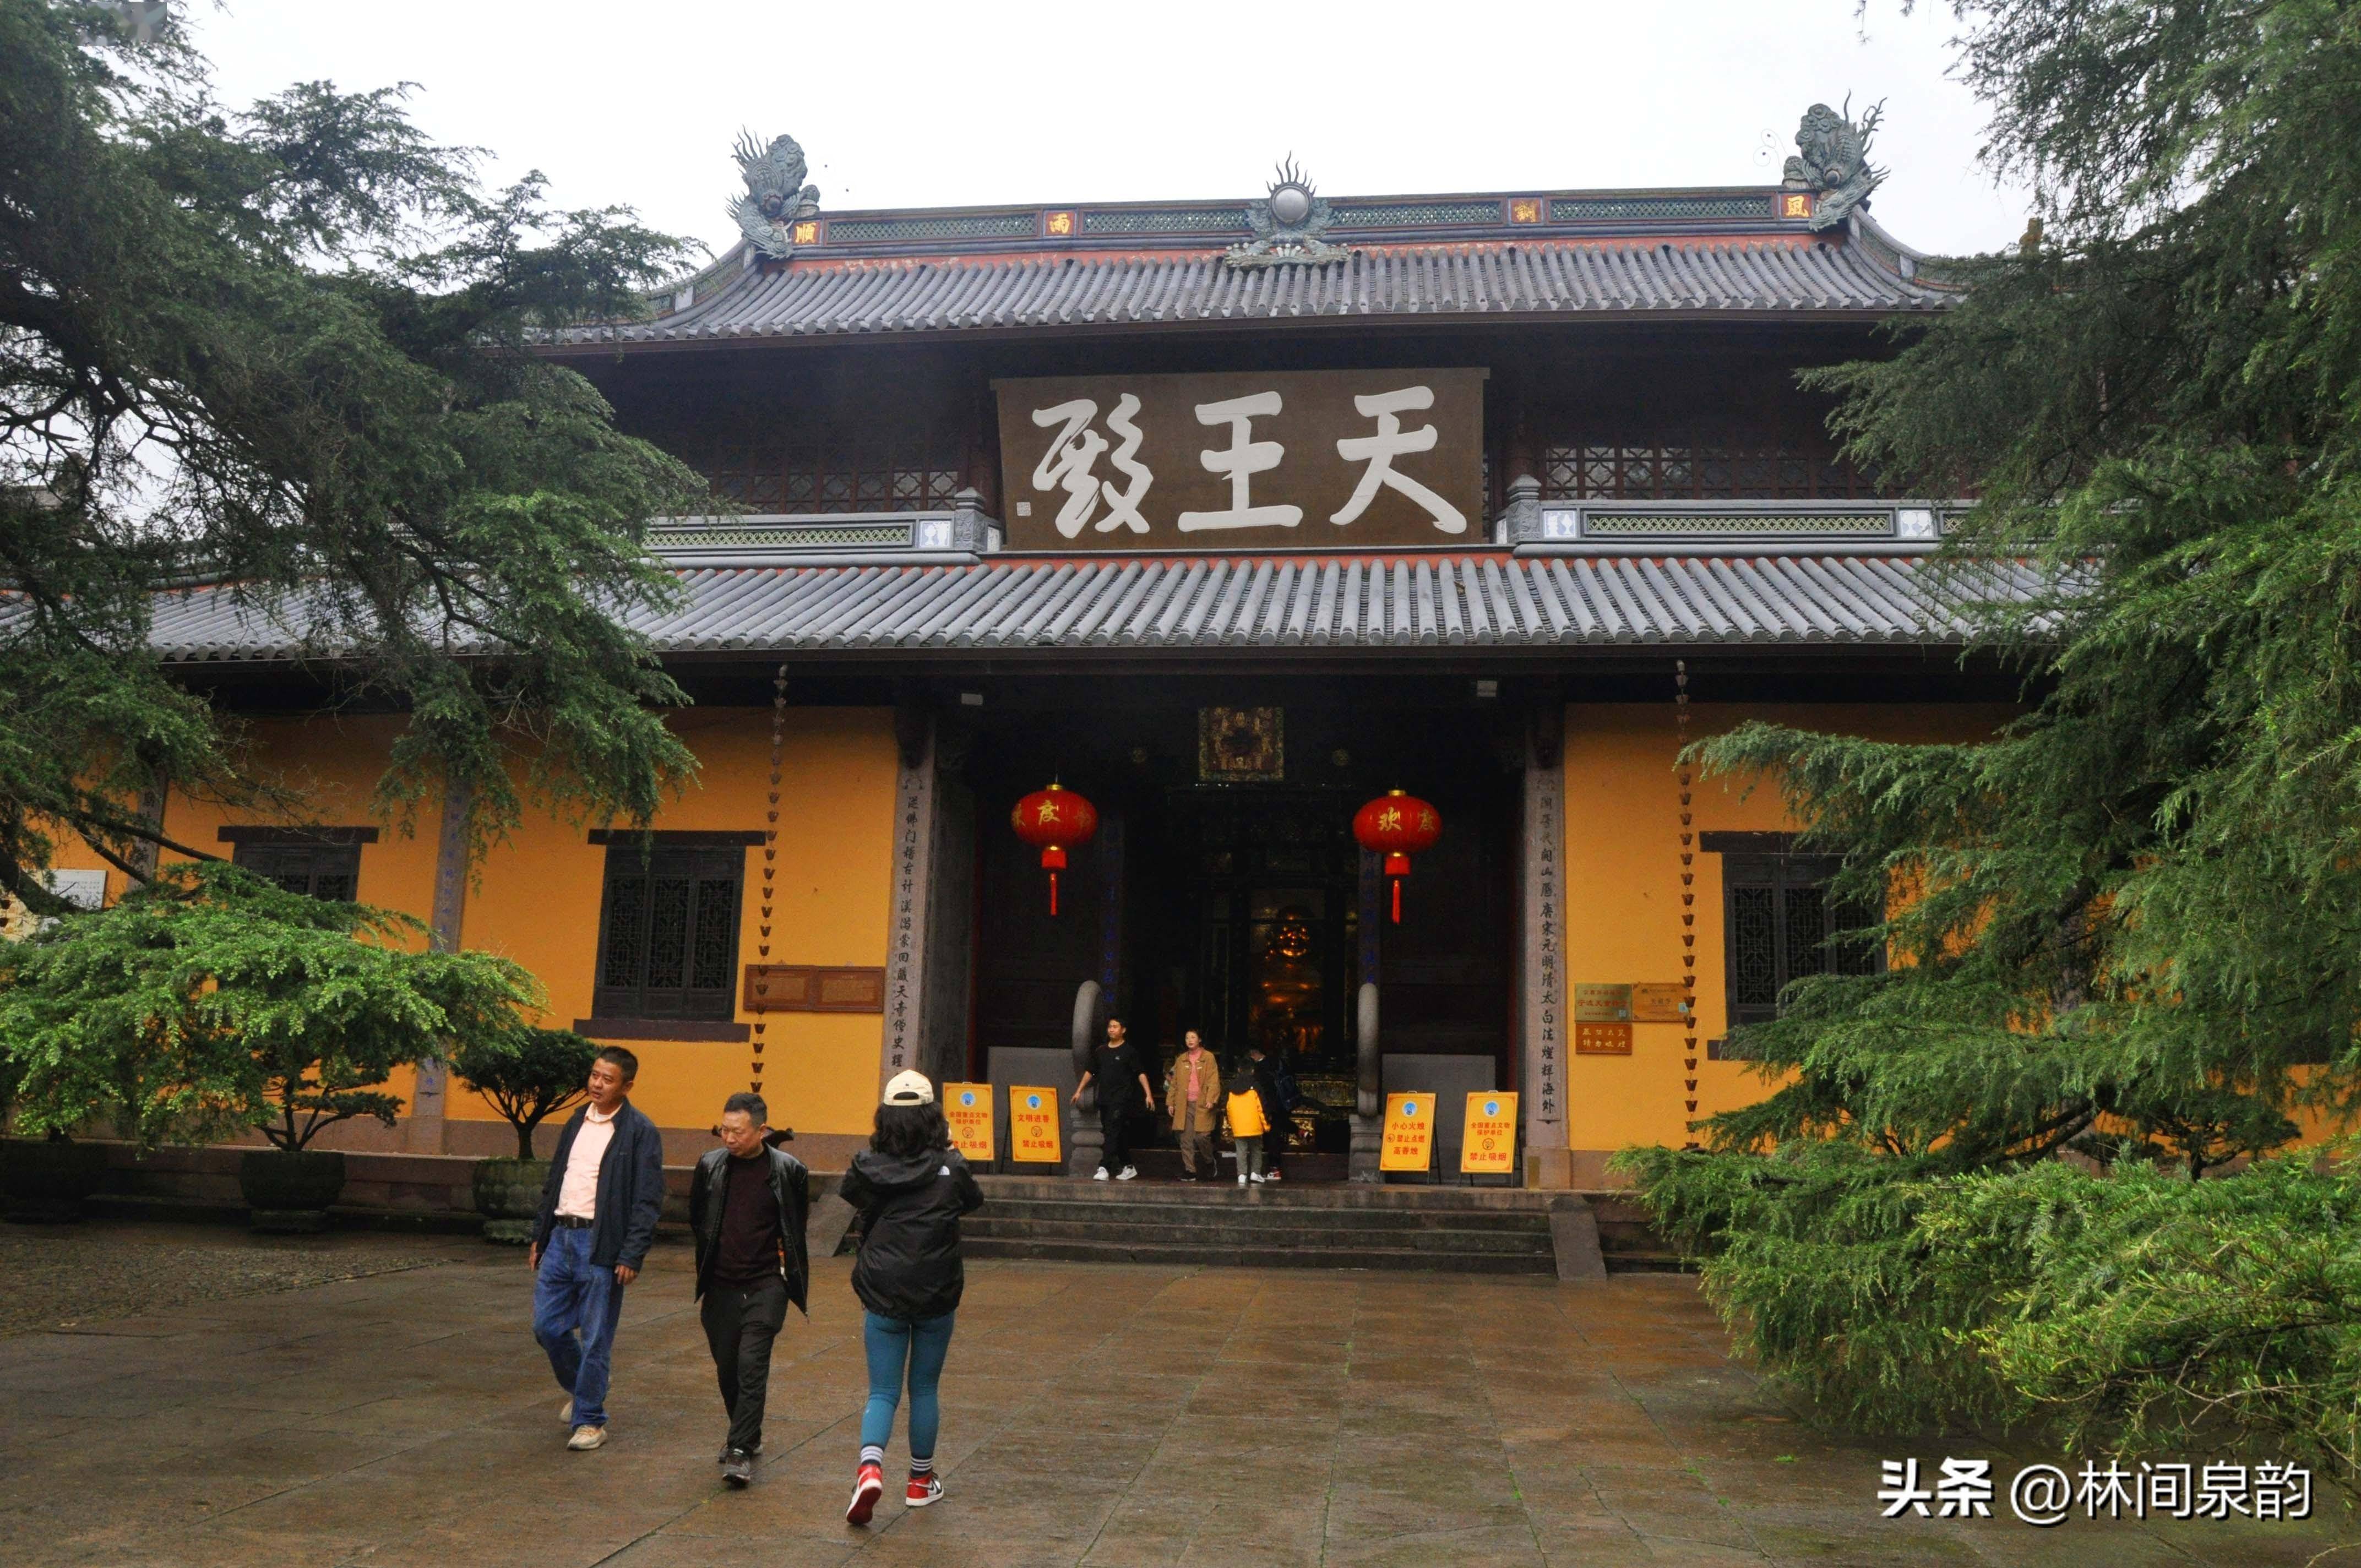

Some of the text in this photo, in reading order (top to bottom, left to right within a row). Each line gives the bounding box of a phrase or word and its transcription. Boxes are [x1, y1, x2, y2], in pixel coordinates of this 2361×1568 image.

[1049, 213, 1070, 233] 雨
[1032, 385, 1467, 538] 天王殿
[1018, 1114, 1050, 1123] 文明进香
[1391, 1122, 1425, 1130] 小心火烛
[1022, 1139, 1053, 1148] 禁止吸烟
[1396, 1135, 1426, 1143] 禁止点燃
[1393, 1146, 1418, 1155] 高香烛
[1469, 1152, 1507, 1161] 禁止吸烟
